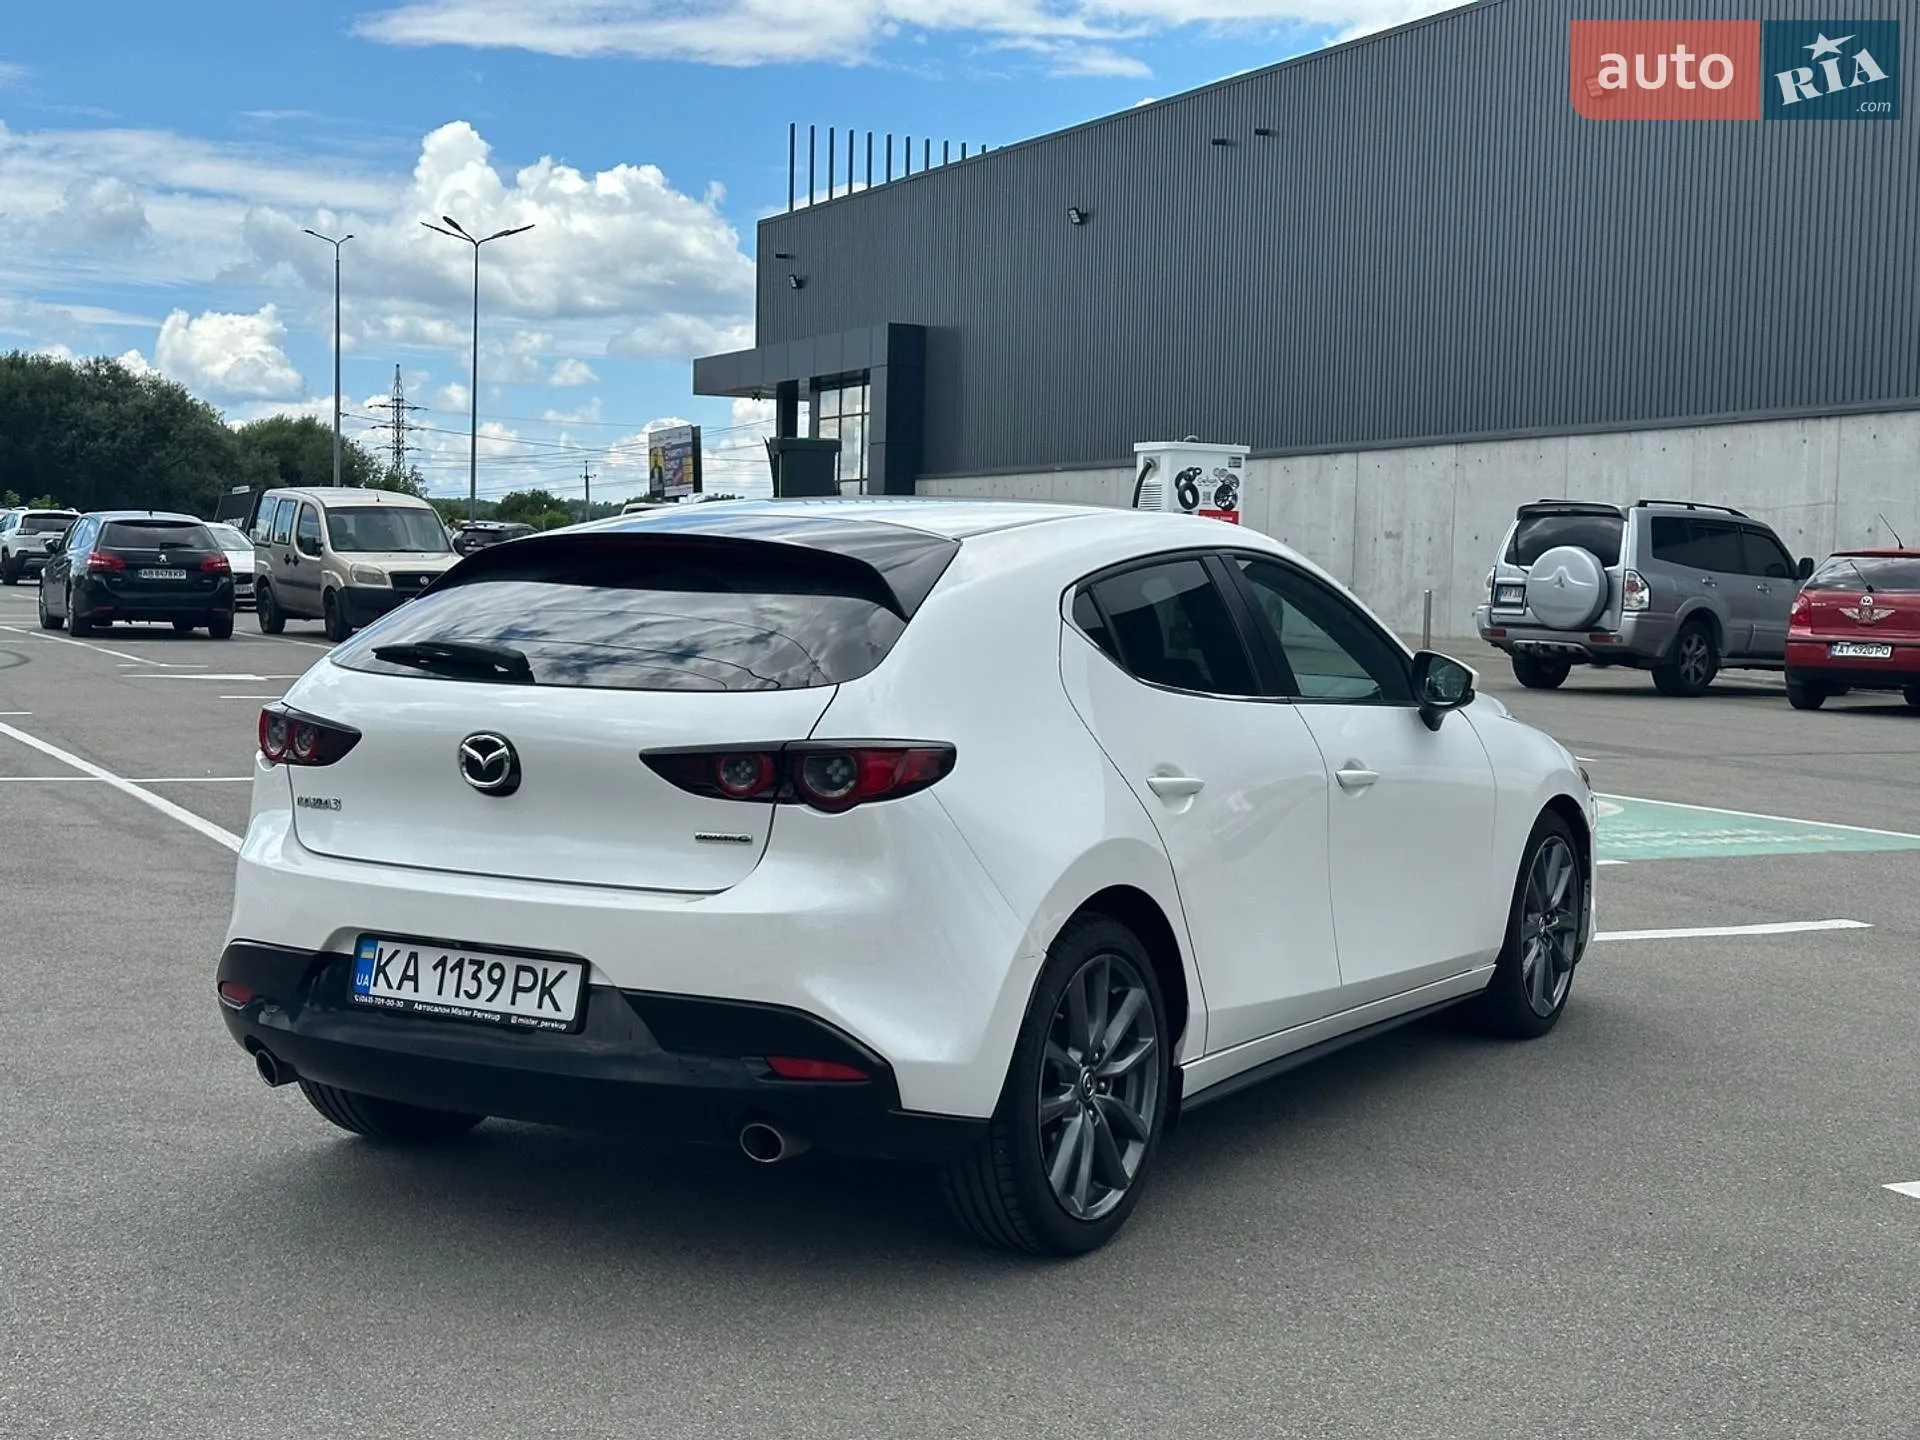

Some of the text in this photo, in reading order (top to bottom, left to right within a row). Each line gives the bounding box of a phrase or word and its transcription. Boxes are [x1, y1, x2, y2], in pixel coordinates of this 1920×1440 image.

[1838, 645, 1850, 654] AT
[356, 973, 369, 986] UA
[372, 947, 568, 1012] KA 1139 PK
[413, 1002, 450, 1014] Автосалон
[451, 1006, 471, 1018] Mister
